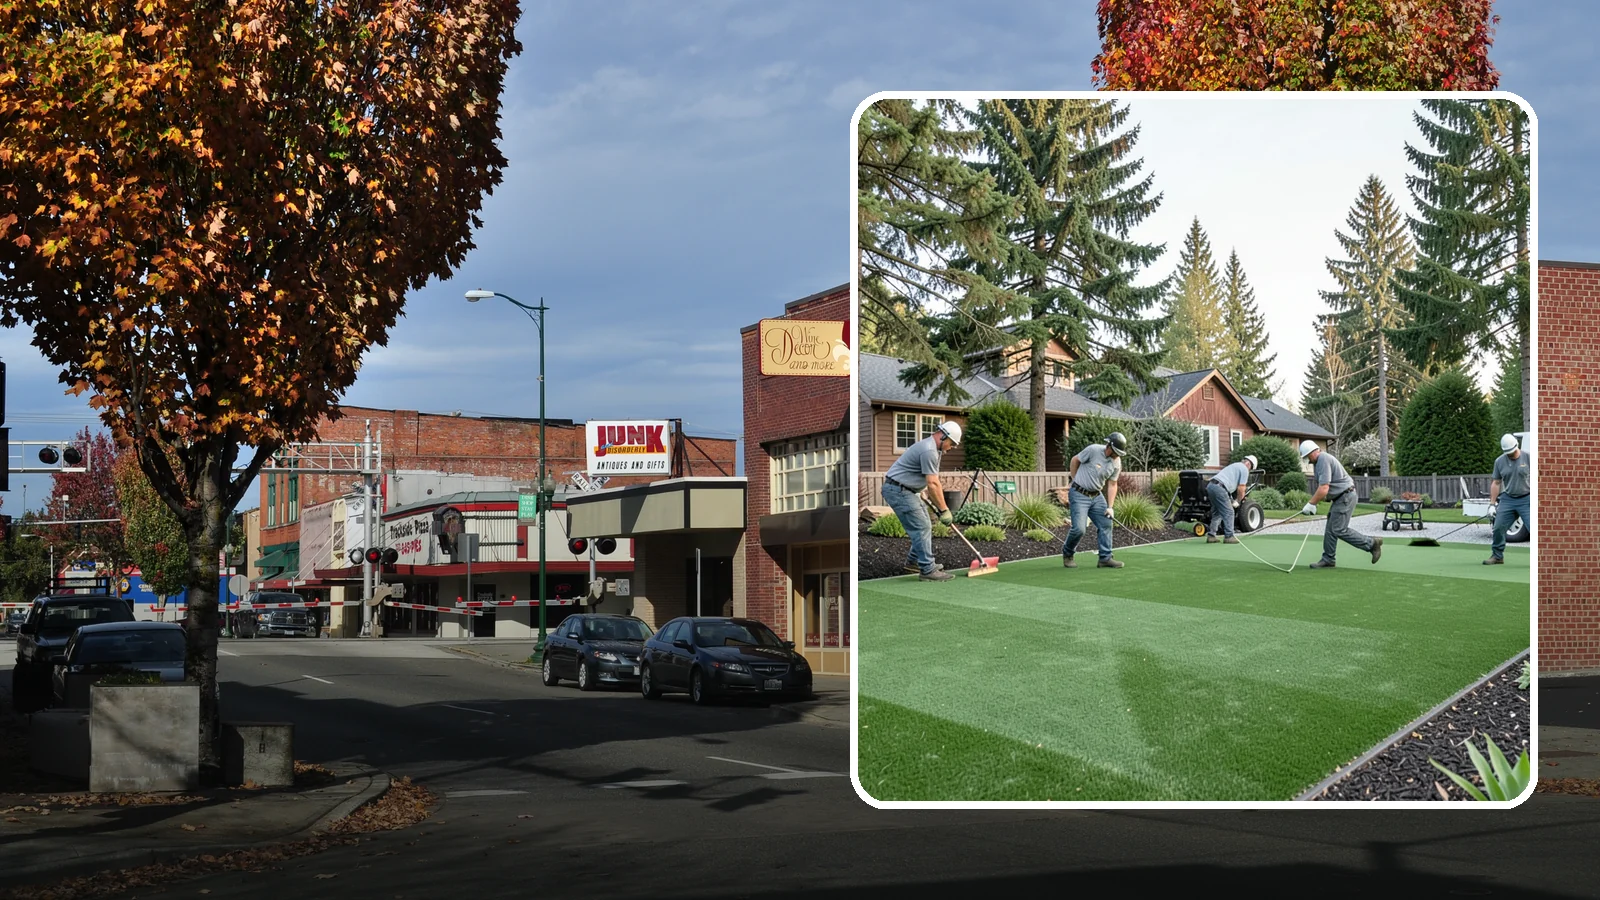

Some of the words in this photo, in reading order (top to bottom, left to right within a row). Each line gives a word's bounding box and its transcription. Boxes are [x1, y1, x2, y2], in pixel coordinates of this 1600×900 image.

[596, 425, 664, 457] JUNK
[607, 446, 646, 454] DISORDERLY
[596, 461, 628, 470] ANTIQUES
[631, 461, 644, 470] AND
[646, 460, 665, 470] GIFTS
[415, 519, 429, 535] Pizza
